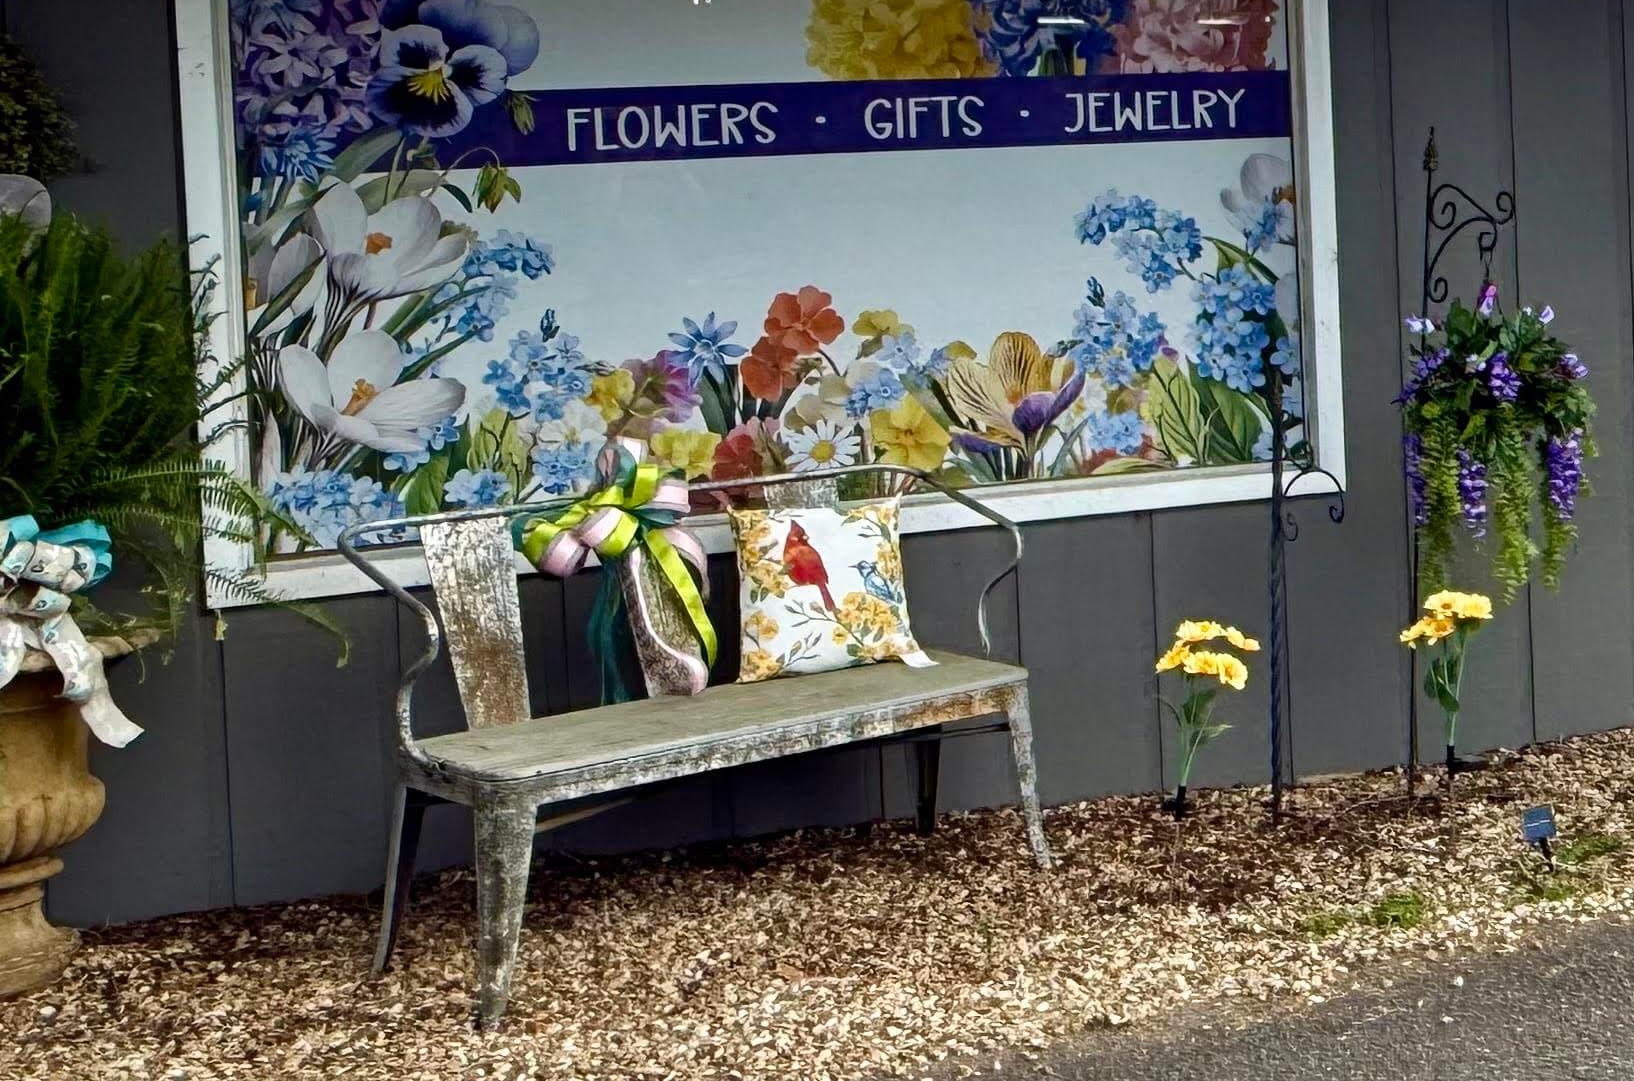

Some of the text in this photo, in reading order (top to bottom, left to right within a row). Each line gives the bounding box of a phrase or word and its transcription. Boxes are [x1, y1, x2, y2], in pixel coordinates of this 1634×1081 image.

[566, 88, 1246, 151] FLOWERS GIFTS JEWELRY
